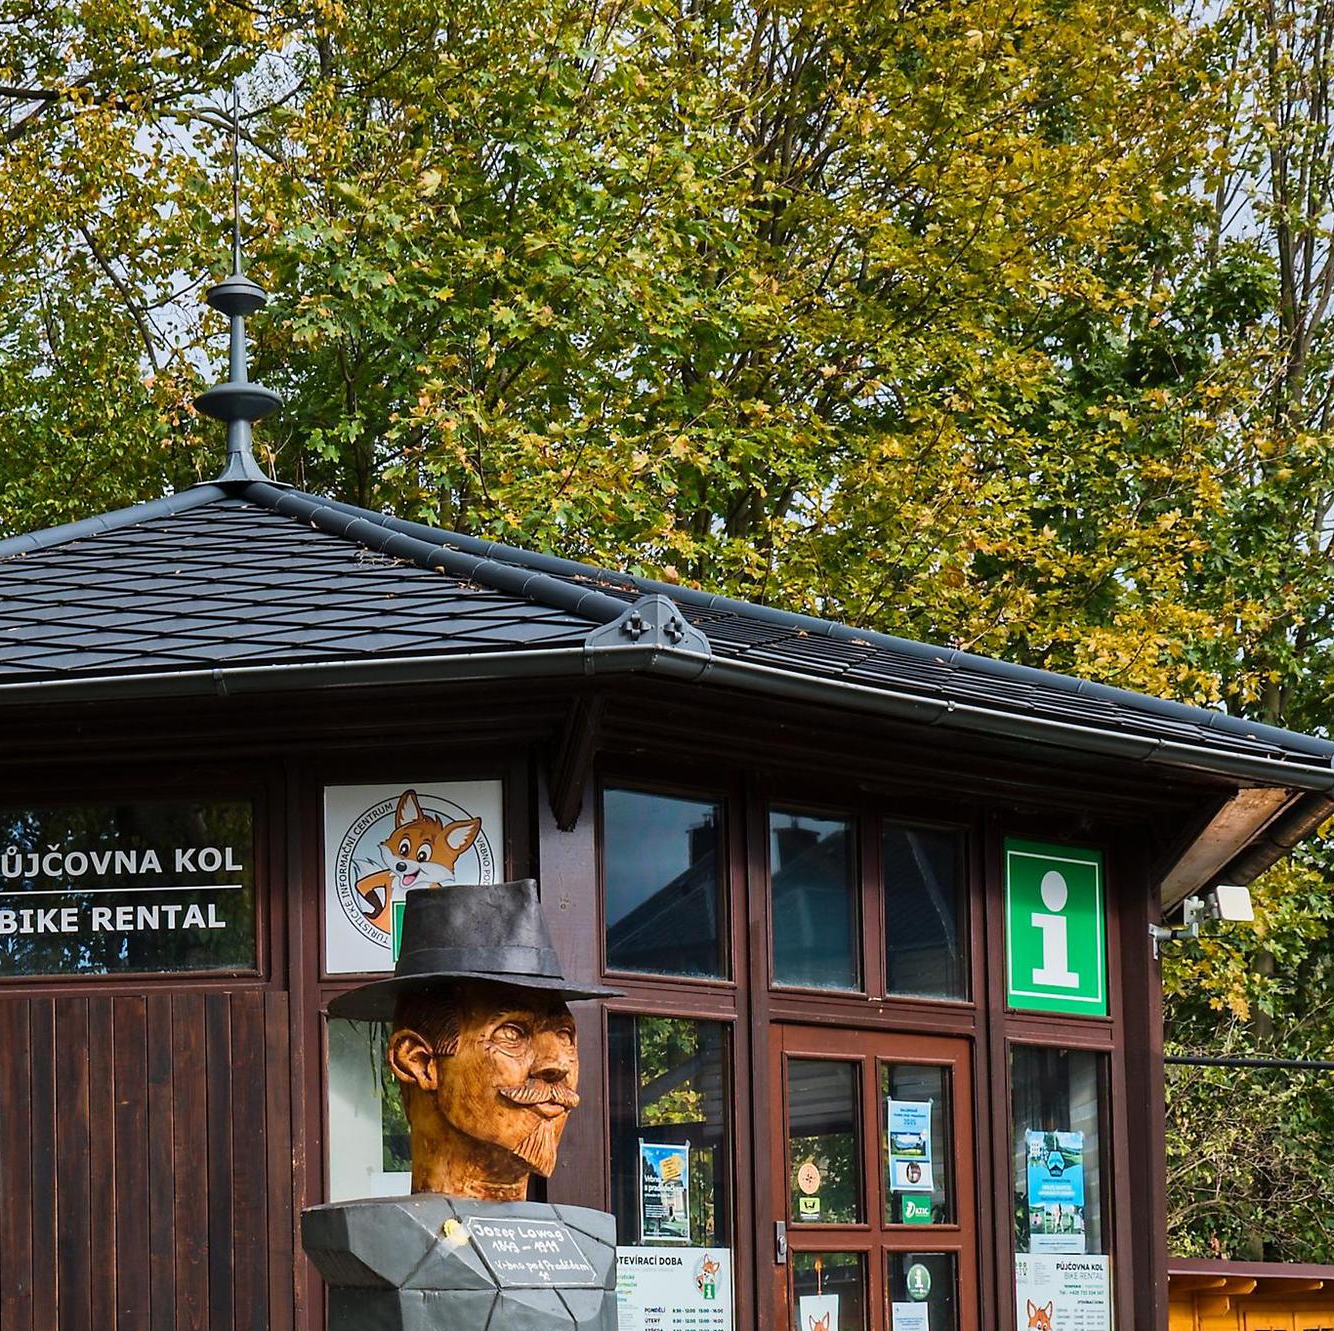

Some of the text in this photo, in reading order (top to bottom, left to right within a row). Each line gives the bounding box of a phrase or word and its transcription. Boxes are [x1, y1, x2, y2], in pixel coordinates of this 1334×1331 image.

[338, 835, 356, 899] INFORMAČNÍ
[353, 802, 394, 836] CENTRUM
[476, 837, 491, 868] VRBNO
[174, 847, 244, 874] KOL
[91, 903, 227, 933] RENTAL
[517, 1226, 565, 1242] Lowag
[534, 1240, 560, 1254] 1911
[659, 1256, 683, 1266] DOBA
[1056, 1261, 1104, 1272] PŮJČOVNA KOL
[1064, 1272, 1104, 1281] BIKE RENTAL
